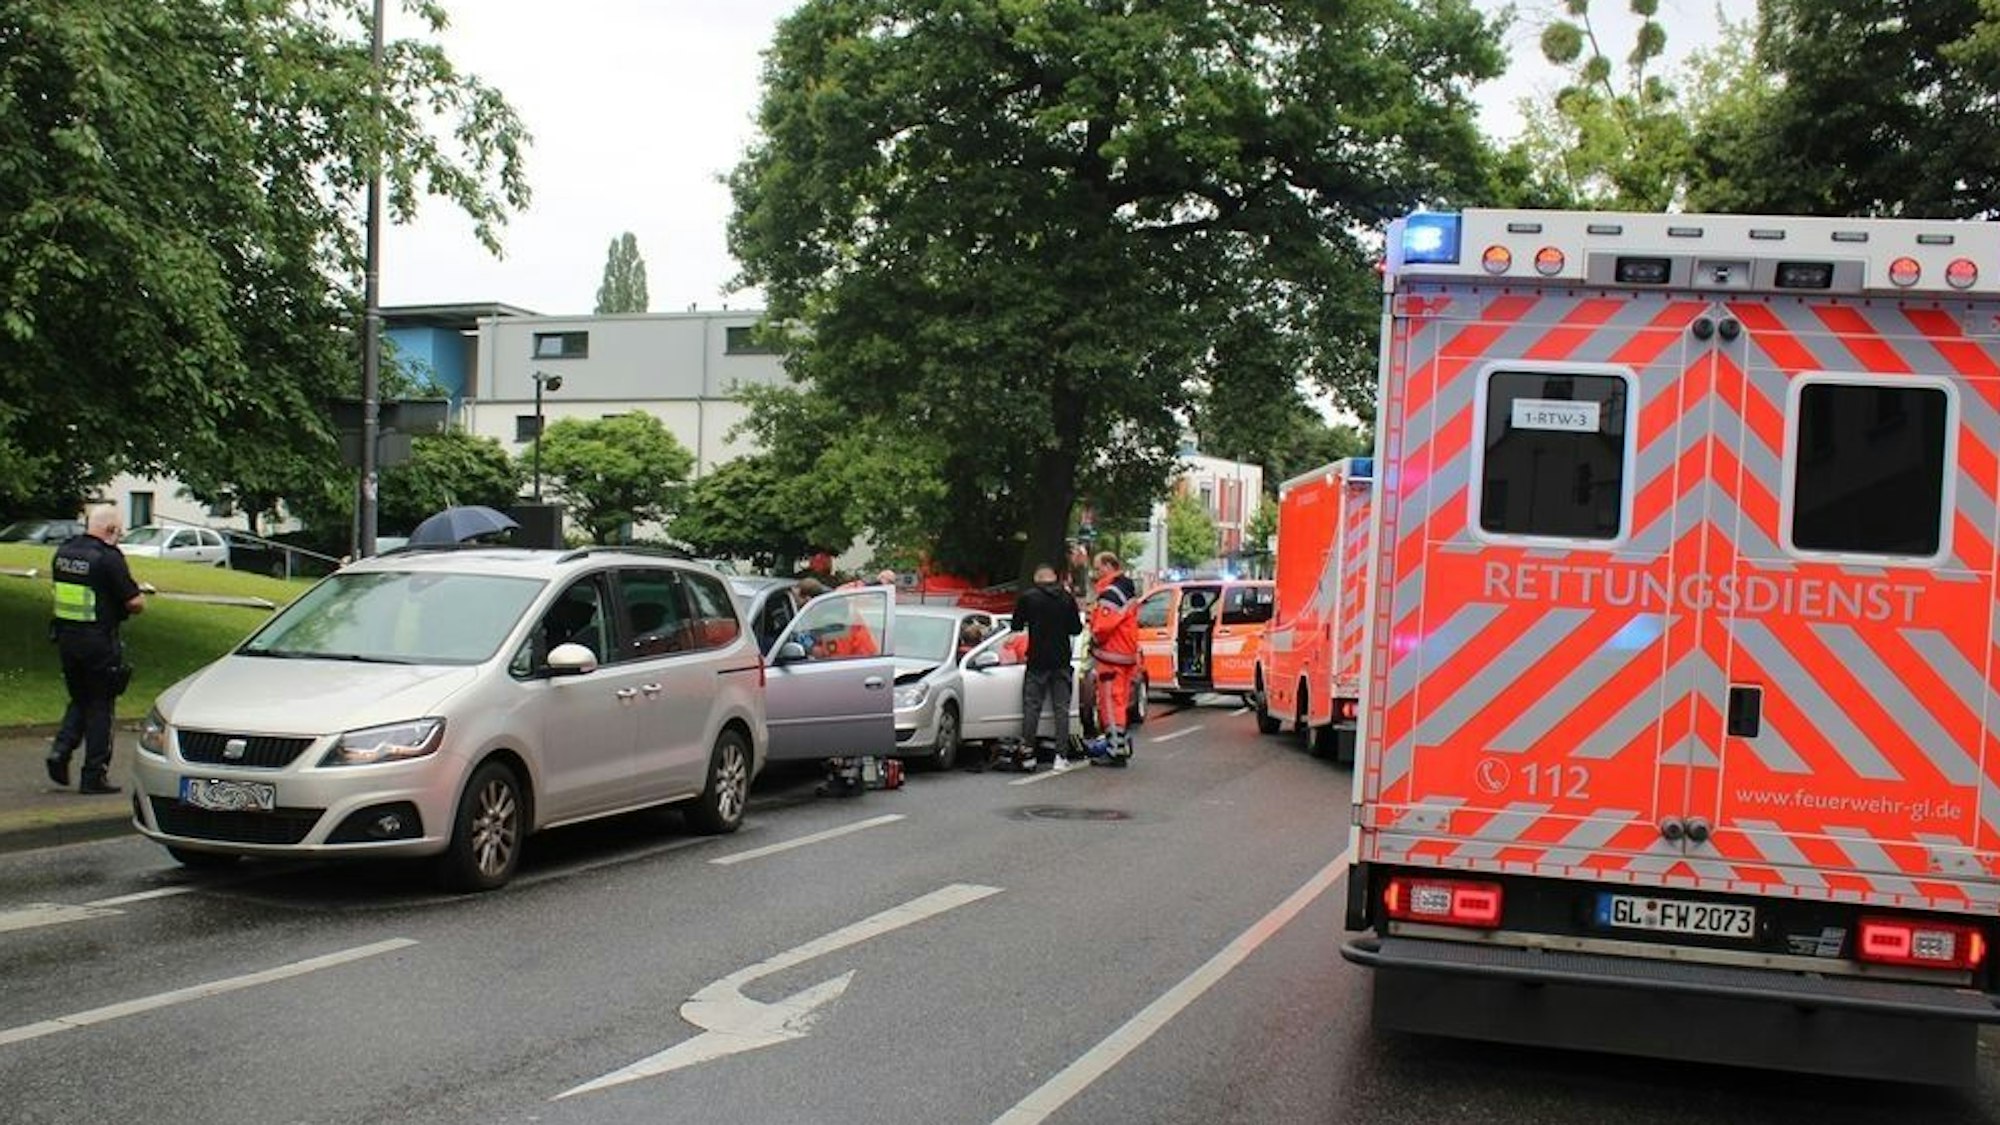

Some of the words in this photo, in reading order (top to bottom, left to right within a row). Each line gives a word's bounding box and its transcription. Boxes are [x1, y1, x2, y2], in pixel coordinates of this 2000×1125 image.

[1524, 411, 1588, 426] 1-RTW-3
[56, 557, 90, 575] POLIZEI
[1483, 561, 1926, 622] RETTUNGSDIENST
[1520, 762, 1590, 799] 112
[1736, 788, 1961, 821] www.feuerwehr-gl.de
[1614, 900, 1641, 925] GL
